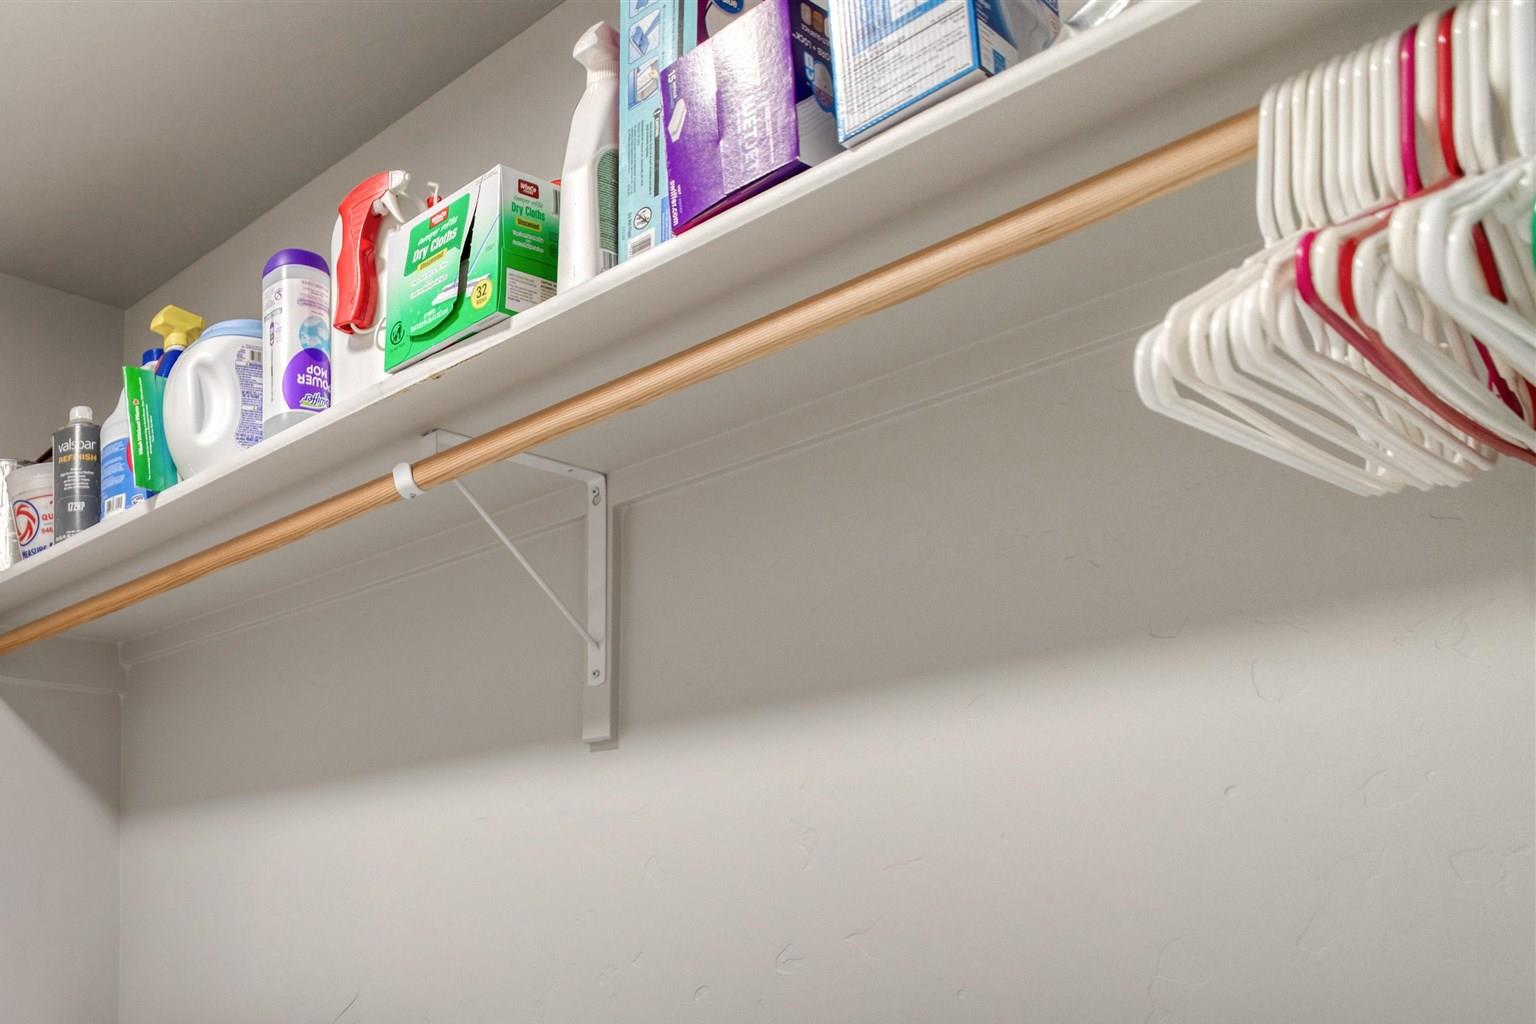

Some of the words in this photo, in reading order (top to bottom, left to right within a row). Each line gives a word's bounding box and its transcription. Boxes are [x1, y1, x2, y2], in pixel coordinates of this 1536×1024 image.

[511, 202, 523, 216] Dry
[525, 206, 546, 221] Cloths
[412, 245, 430, 264] Dry
[430, 227, 459, 252] Cloths
[476, 283, 488, 299] 32
[297, 374, 330, 391] OWER
[58, 438, 97, 453] valspar
